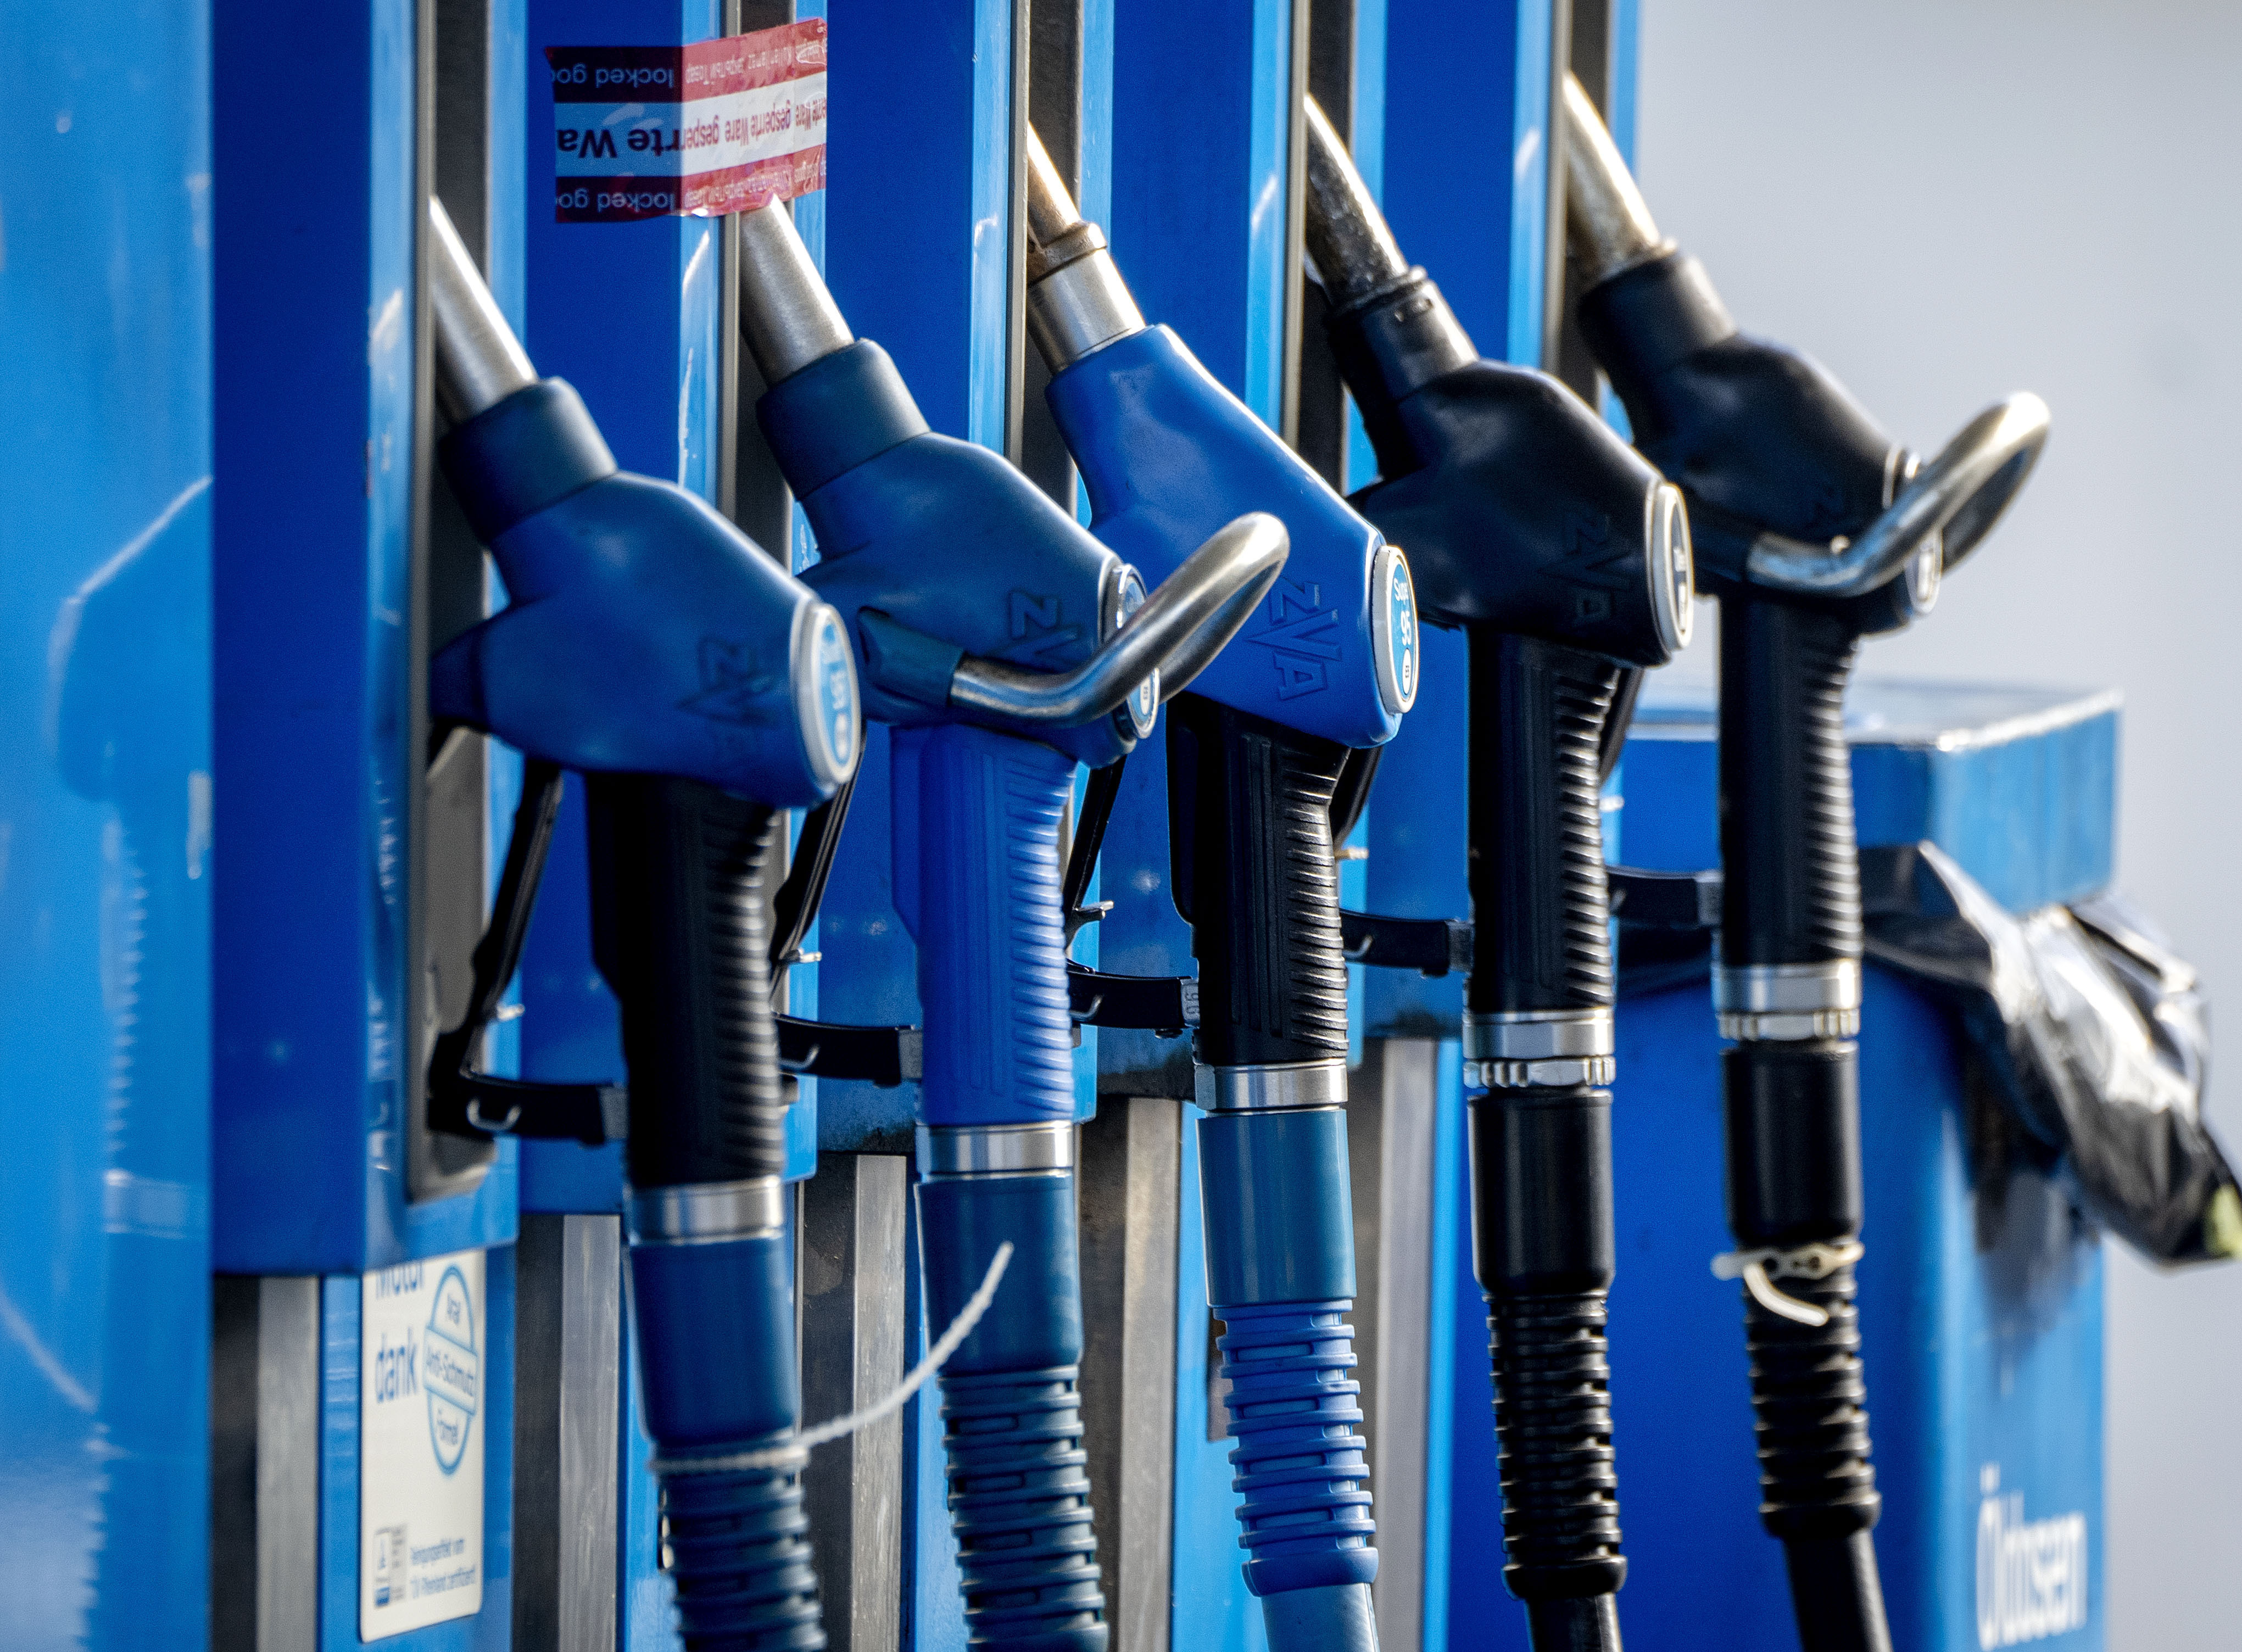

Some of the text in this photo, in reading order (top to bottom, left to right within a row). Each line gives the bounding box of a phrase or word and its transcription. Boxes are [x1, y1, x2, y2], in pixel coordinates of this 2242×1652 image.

[595, 67, 674, 88] locked
[724, 116, 749, 147] Ware
[750, 99, 791, 142] gesperrte
[557, 128, 618, 159] Wa
[556, 188, 590, 209] go
[596, 192, 676, 213] locked
[1244, 576, 1342, 701] ZVA
[1401, 610, 1412, 646] 95
